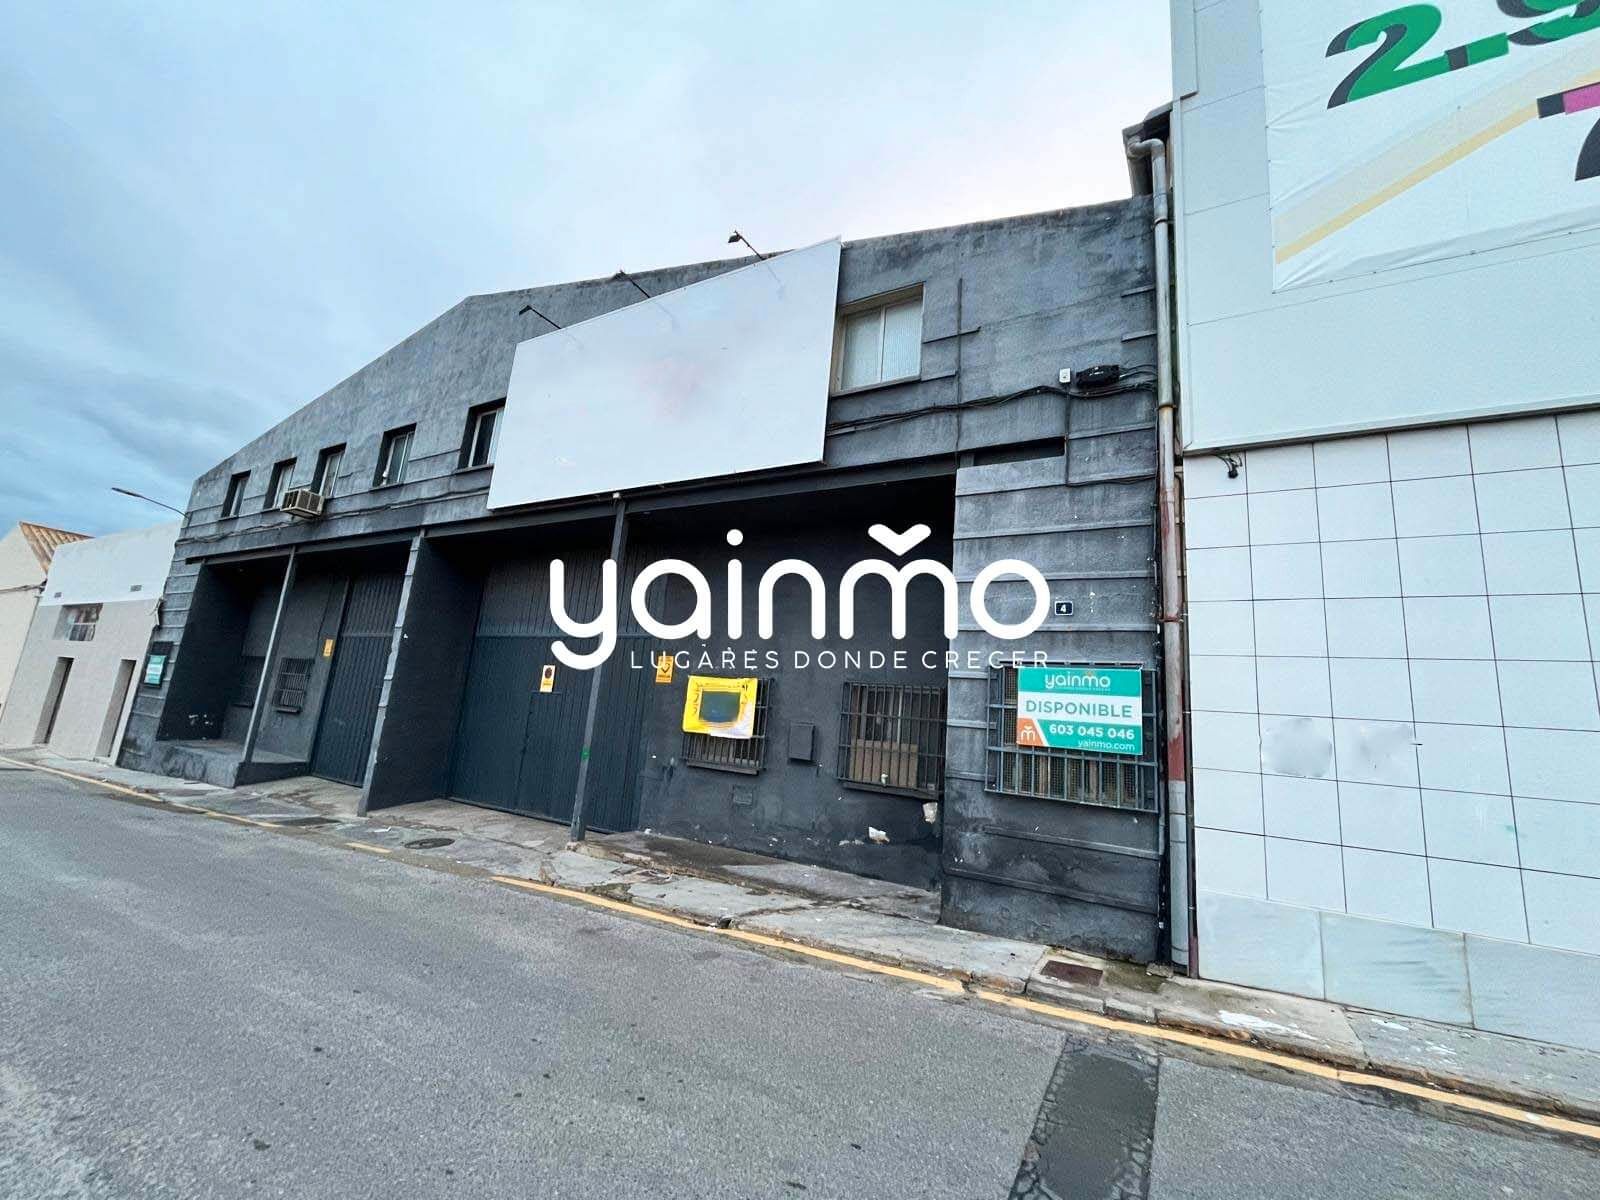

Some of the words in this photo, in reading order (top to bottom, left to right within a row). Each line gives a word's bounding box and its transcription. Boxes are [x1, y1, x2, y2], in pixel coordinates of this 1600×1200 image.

[1045, 672, 1111, 689] yainmo
[1025, 699, 1133, 718] DISPONIBLE
[1049, 723, 1074, 735] 603
[1077, 726, 1104, 737] 045
[1107, 727, 1135, 740] 046
[1078, 739, 1135, 751] yainmo.com
